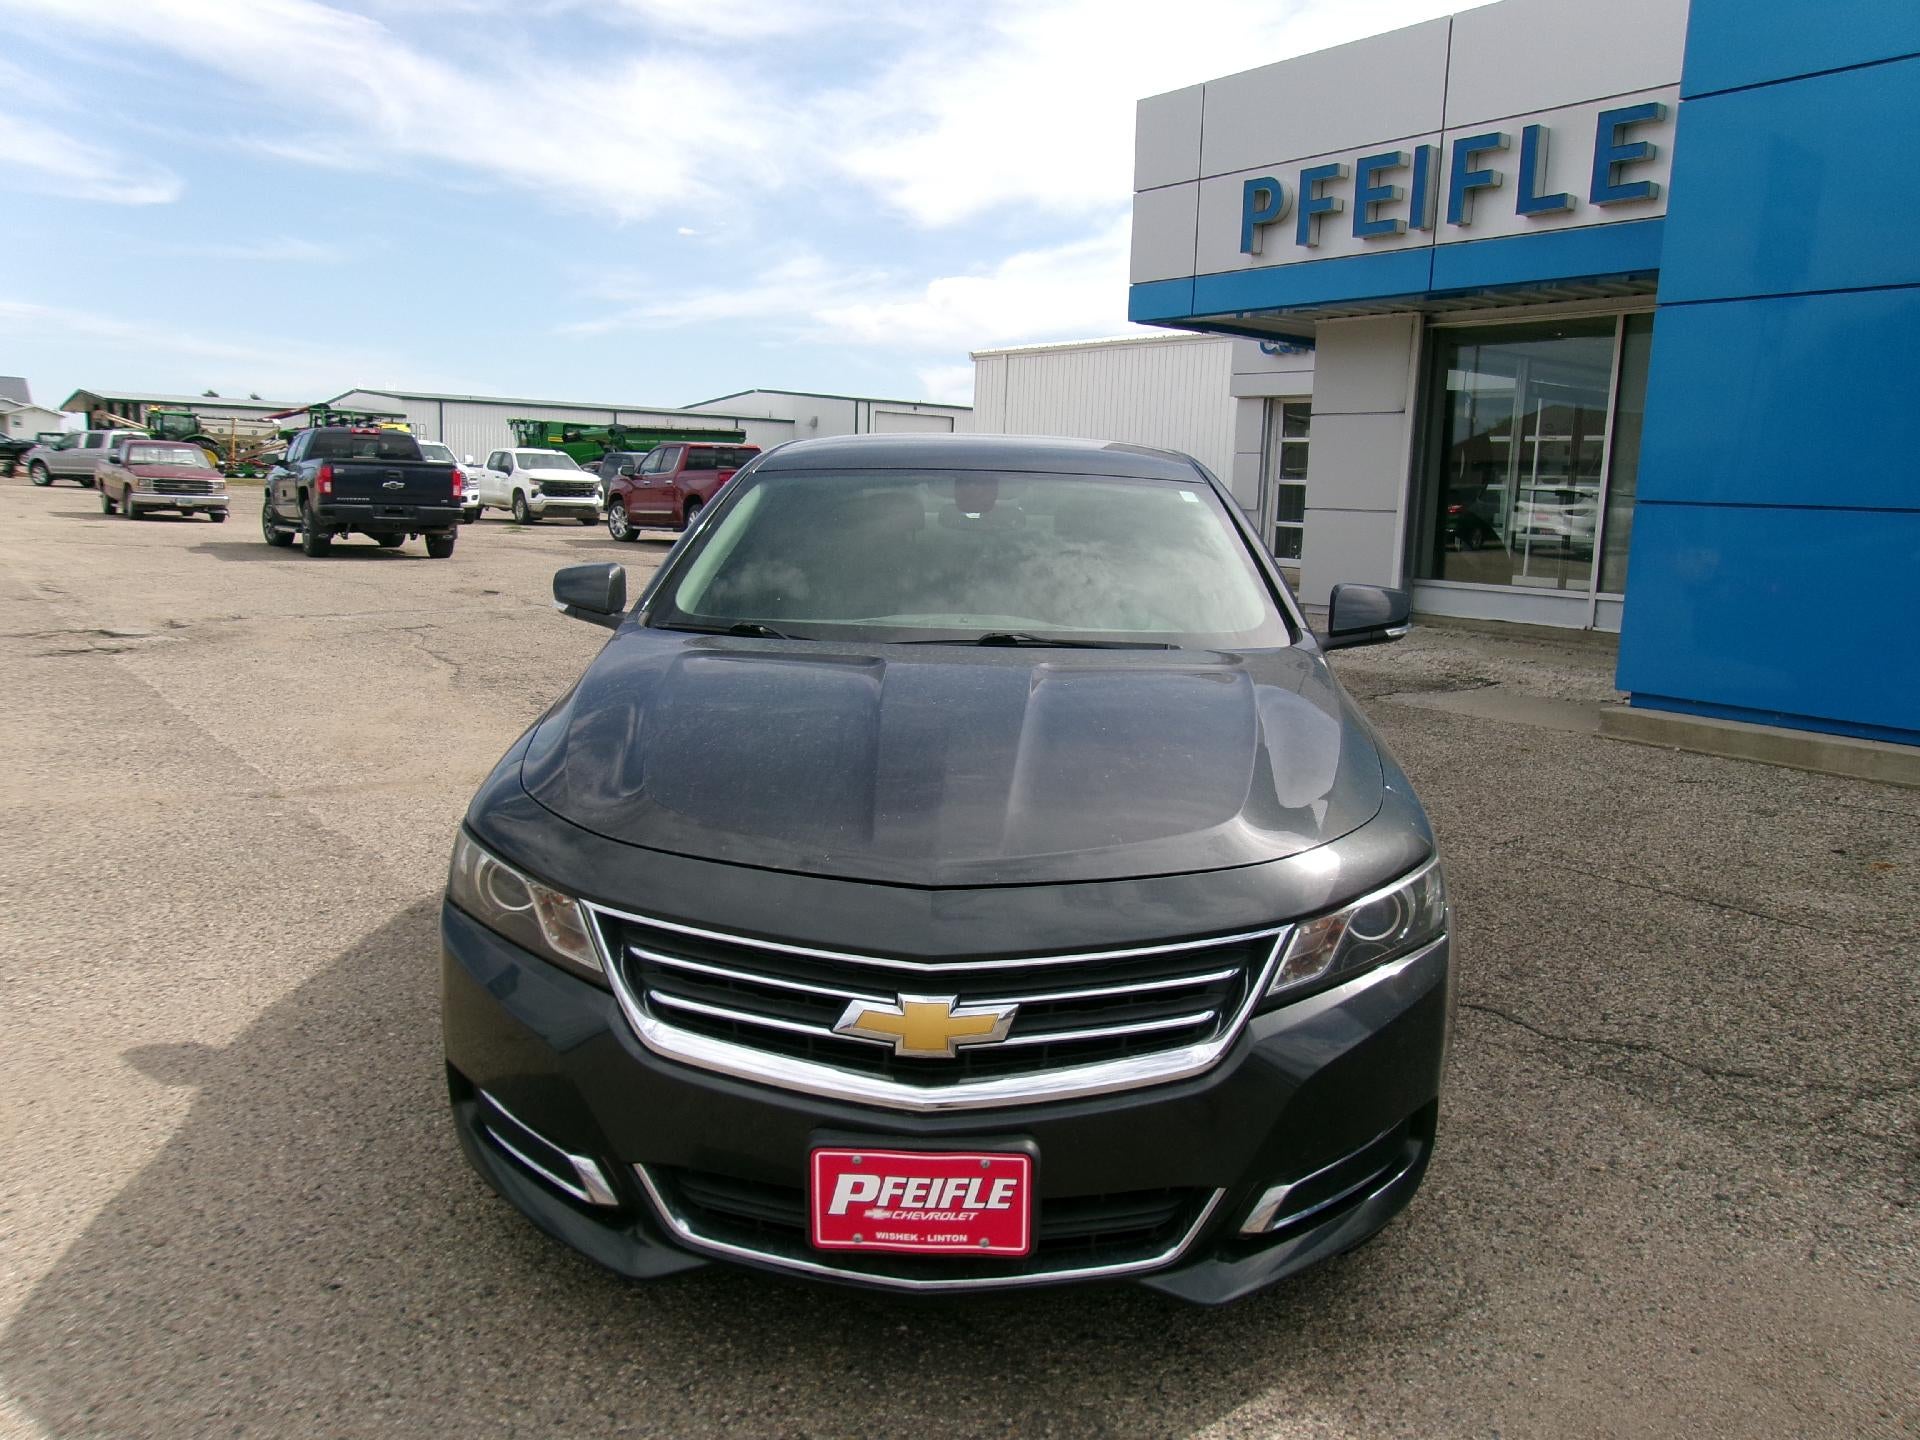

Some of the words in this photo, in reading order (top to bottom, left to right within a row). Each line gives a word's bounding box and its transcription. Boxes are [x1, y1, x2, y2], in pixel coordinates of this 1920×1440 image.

[1239, 101, 1668, 255] PFEIFLE
[827, 1173, 1018, 1216] PFEIFLE
[891, 1210, 979, 1221] CHEVROLET
[875, 1231, 918, 1242] WISHEK
[927, 1233, 968, 1243] LINTON
